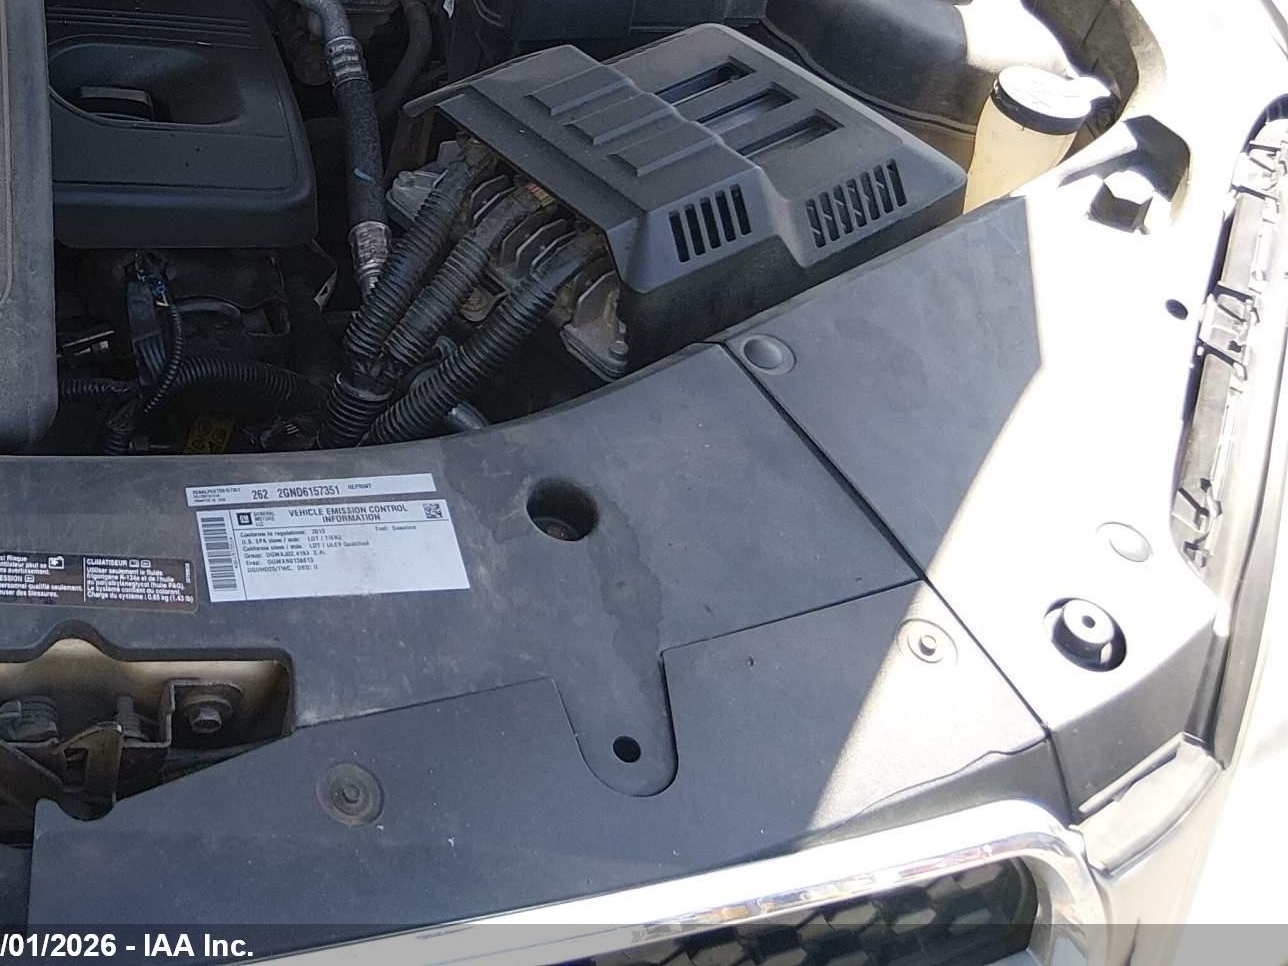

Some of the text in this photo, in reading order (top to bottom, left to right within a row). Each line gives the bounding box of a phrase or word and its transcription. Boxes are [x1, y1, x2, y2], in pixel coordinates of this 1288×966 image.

[252, 489, 269, 499] 262
[277, 485, 340, 498] 2GND6157351
[289, 504, 408, 517] VEHICLE EMISSION CONTROL
[322, 514, 381, 523] INFORMATION
[86, 558, 126, 566] CLIMATISEUR
[86, 591, 108, 599] Charge
